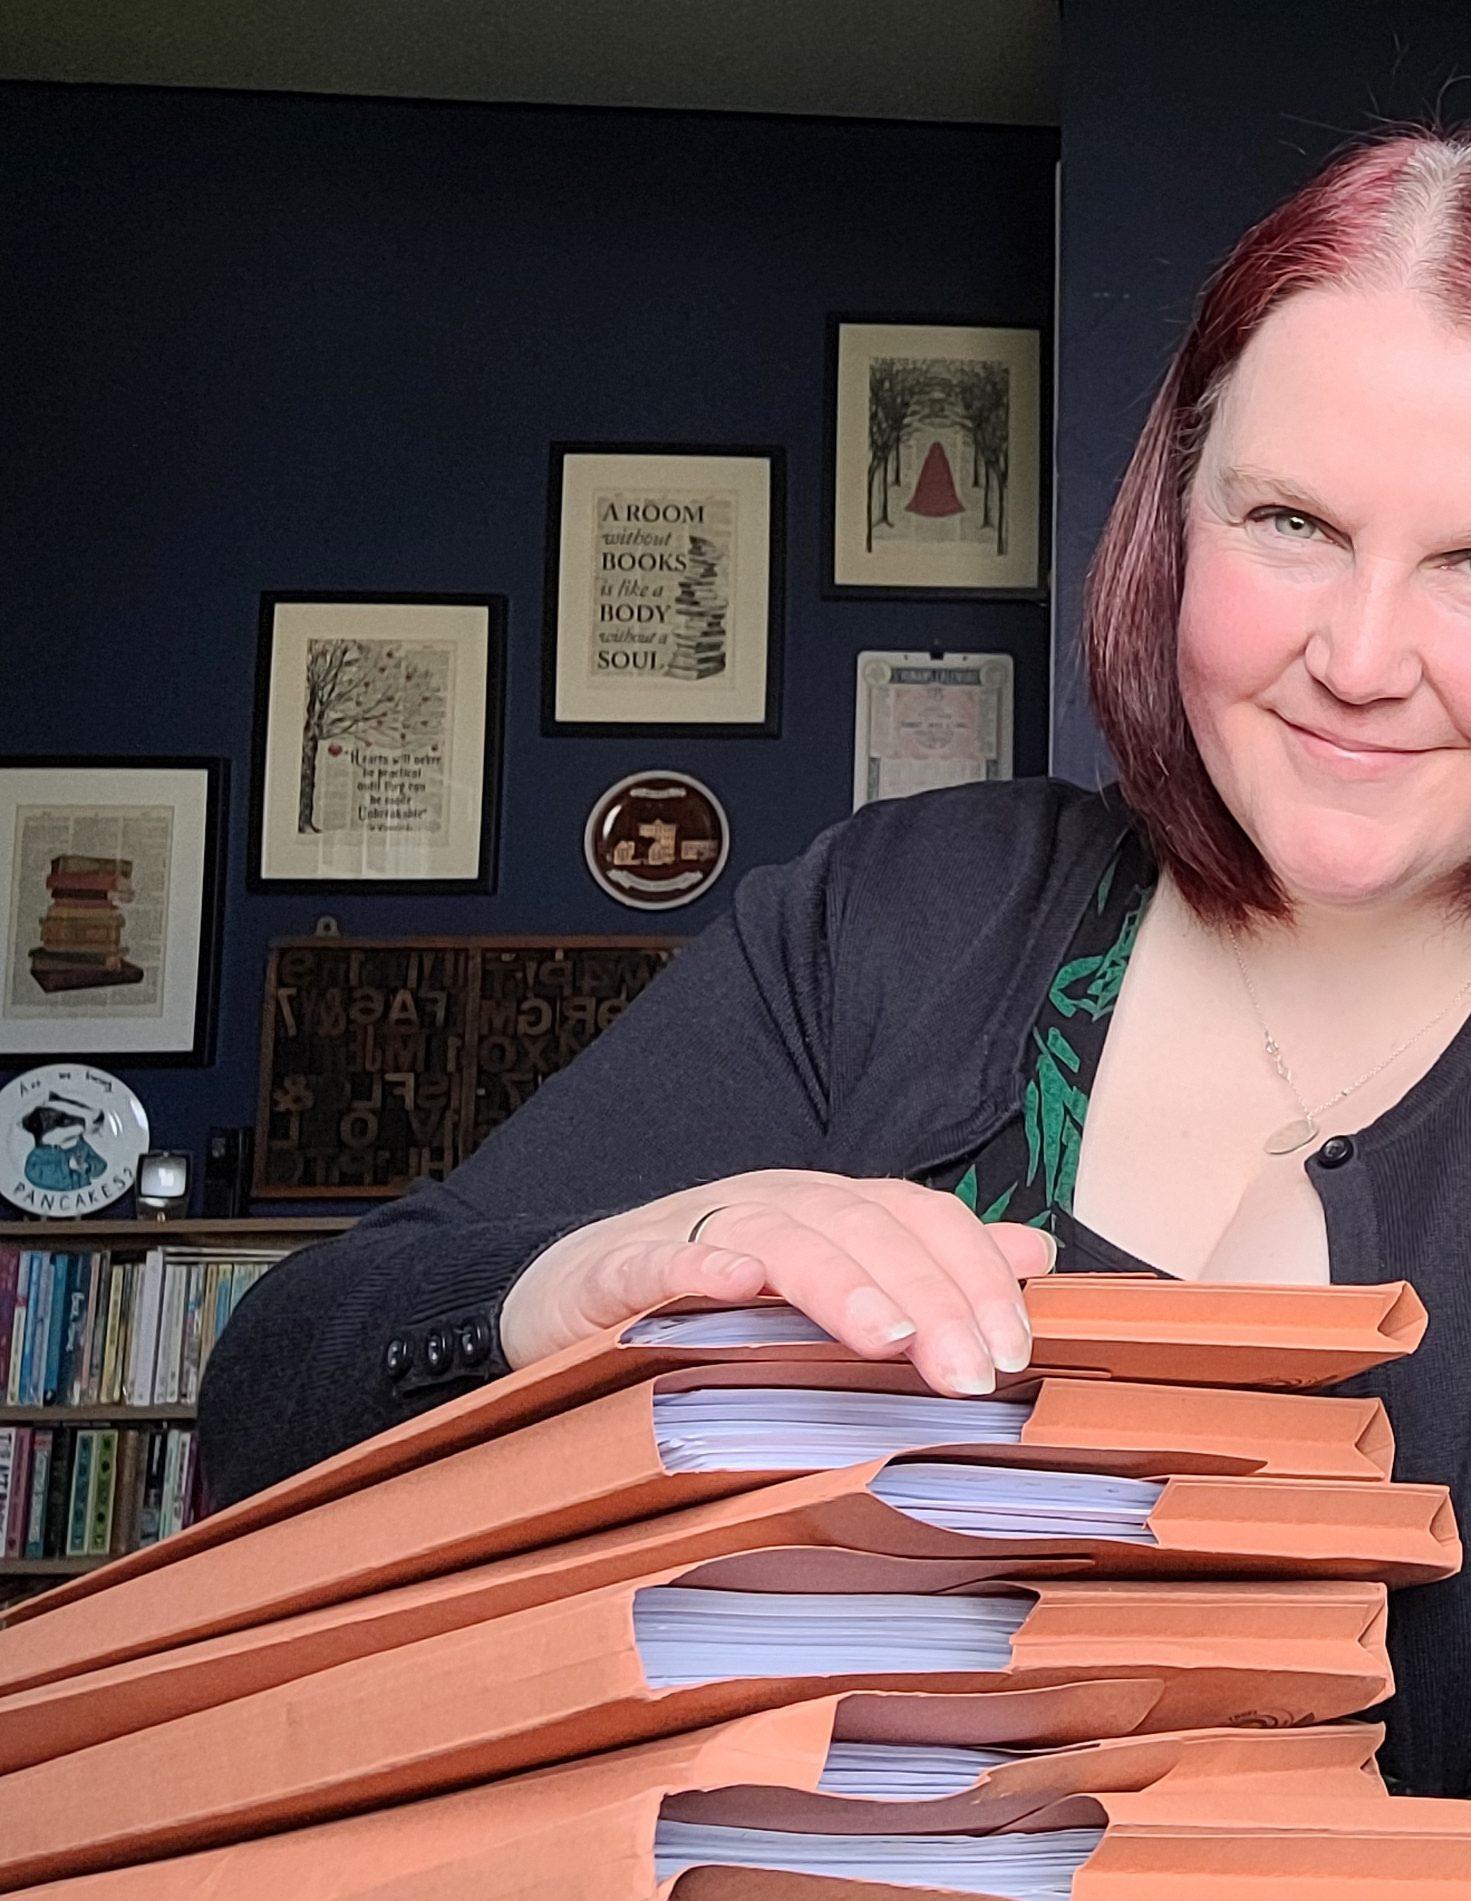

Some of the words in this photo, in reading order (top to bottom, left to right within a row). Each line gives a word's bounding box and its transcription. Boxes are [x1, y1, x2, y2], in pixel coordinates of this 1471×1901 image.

[602, 502, 619, 522] A
[625, 502, 705, 525] ROOM
[601, 526, 673, 547] without
[601, 551, 688, 573] BOOKS
[600, 578, 613, 598] is
[616, 577, 651, 599] like
[651, 584, 664, 599] a
[599, 602, 672, 625] BODY
[598, 627, 658, 645] without
[658, 633, 669, 646] a
